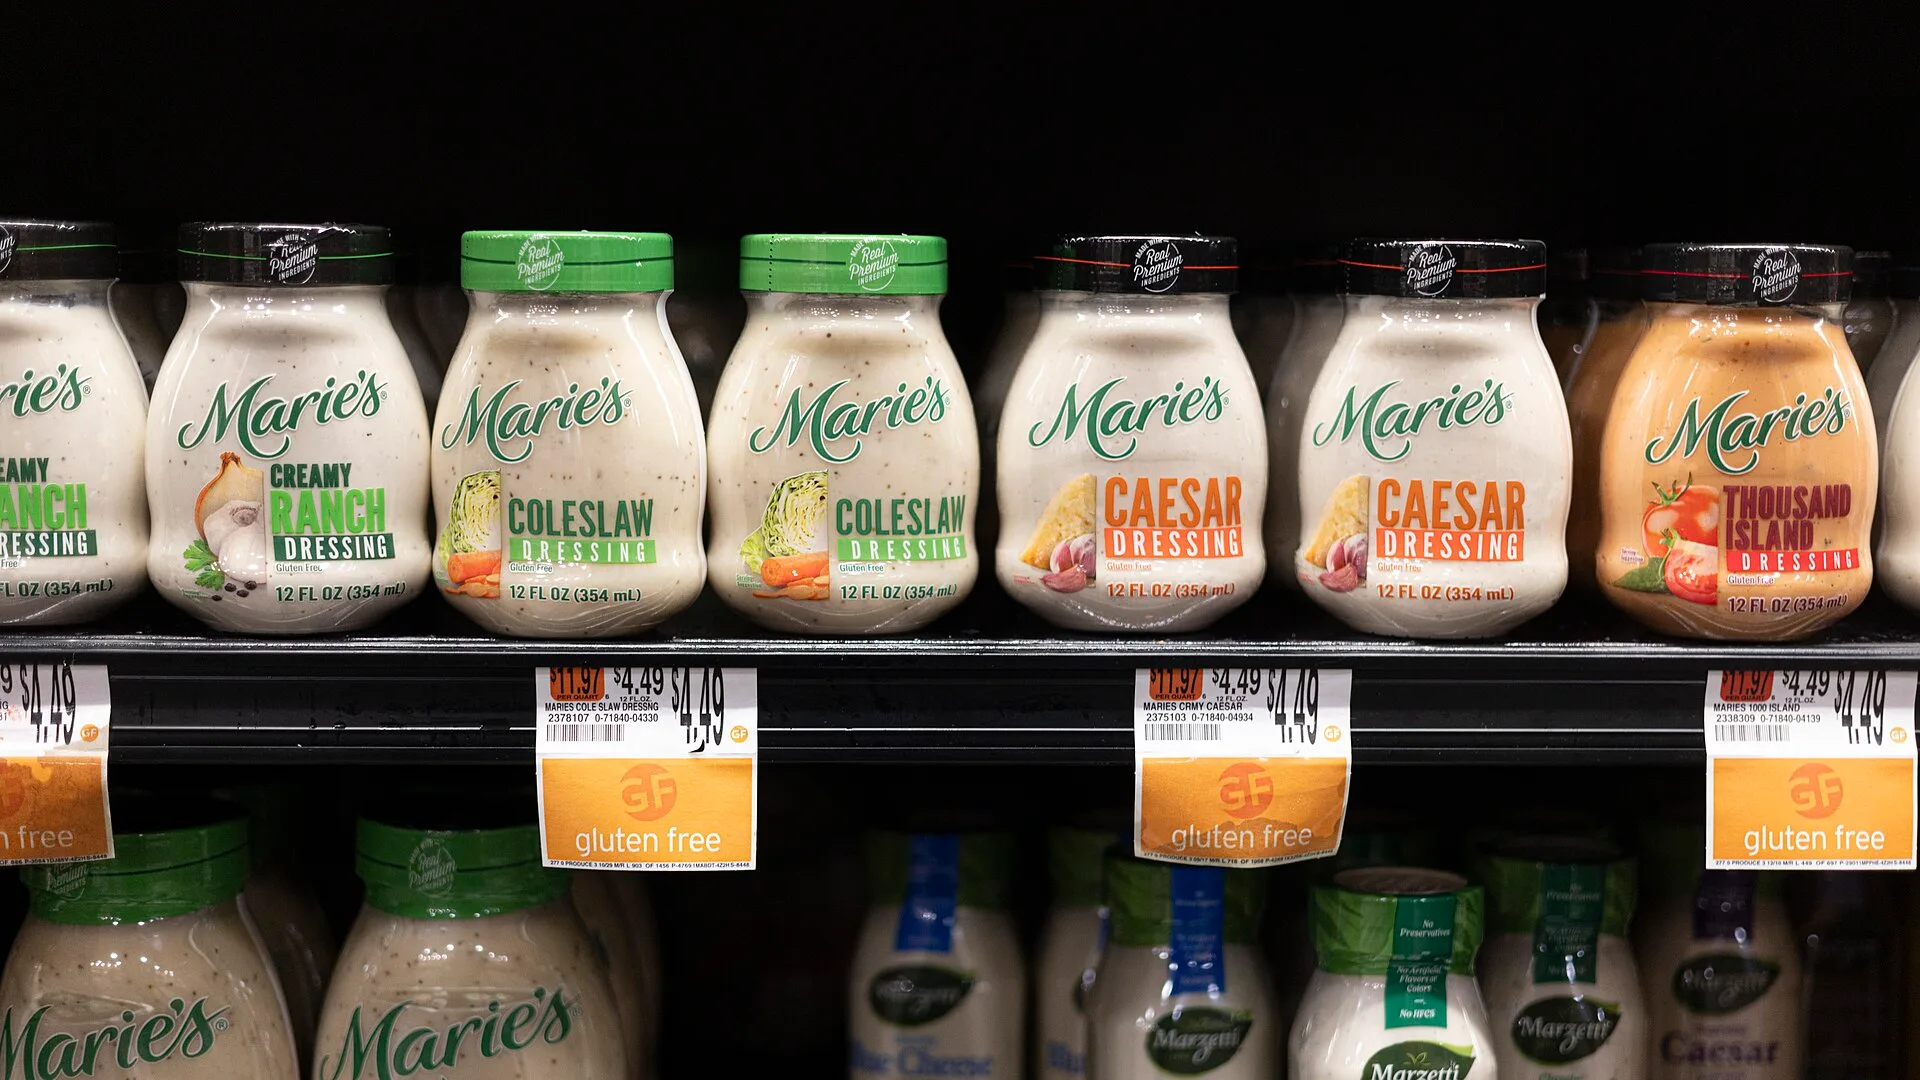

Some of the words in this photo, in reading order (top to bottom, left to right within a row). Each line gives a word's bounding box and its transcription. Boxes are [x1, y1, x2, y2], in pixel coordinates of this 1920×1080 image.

[528, 240, 551, 263] Real
[850, 239, 865, 257] MADE
[861, 240, 886, 264] Real
[1135, 242, 1149, 259] MADE
[1145, 243, 1171, 266] Real
[1418, 246, 1444, 268] Real
[269, 244, 319, 276] Premium
[278, 257, 317, 281] INGREDIENTS
[517, 251, 565, 280] Premium
[849, 252, 900, 281] Premium
[1133, 254, 1184, 282] Premium
[1406, 257, 1457, 285] Premium
[1753, 251, 1767, 270] MADE
[1763, 252, 1789, 276] Real
[524, 263, 562, 285] INGREDIENTS
[857, 264, 896, 286] INGREDIENTS
[1141, 266, 1180, 287] INGREDIENTS
[1413, 269, 1453, 290] INGREDIENTS
[1752, 262, 1802, 293] Premium
[1760, 275, 1799, 298] INGREDIENTS
[177, 369, 388, 458] Marie's
[441, 377, 634, 463] Marie's
[749, 376, 950, 463] Marie's
[1028, 376, 1231, 461] Marie's
[1313, 378, 1516, 462] Marie's
[1645, 387, 1851, 475] Marie's
[270, 463, 352, 488] CREAMY
[270, 488, 386, 534] RANCH
[1104, 476, 1242, 528] CAESAR
[1377, 478, 1526, 531] CAESAR
[1723, 483, 1852, 522] THOUSAND
[509, 498, 654, 538] COLESLAW
[836, 496, 967, 536] COLESLAW
[1113, 529, 1239, 557] DRESSING
[1384, 530, 1518, 560] DRESSING
[1726, 518, 1814, 551] ISLAND
[285, 535, 388, 560] DRESSING
[522, 539, 646, 562] DRESSING
[851, 537, 963, 559] DRESSING
[276, 563, 303, 573] Gluten
[510, 563, 534, 573] Gluten
[536, 563, 553, 573] Free
[839, 563, 865, 574] Gluten
[867, 563, 884, 573] Free
[1107, 561, 1133, 571] Gluten
[1377, 561, 1402, 573] Gluten
[1742, 551, 1854, 571] DRESSING
[18, 582, 40, 597] OZ
[44, 582, 80, 598] (354
[86, 579, 113, 593] mL)
[1107, 583, 1125, 597] 12
[1129, 583, 1147, 597] FL
[1151, 583, 1171, 597] OZ
[1175, 583, 1208, 599] (354
[1212, 581, 1235, 596] mL)
[1728, 574, 1754, 585] Gluten
[276, 586, 294, 602] 12
[299, 586, 318, 601] FL
[323, 586, 343, 601] OZ
[347, 584, 380, 601] (354
[384, 582, 406, 597] mL)
[510, 585, 525, 600] 12
[530, 585, 547, 600] FL
[551, 586, 570, 601] OZ
[574, 587, 609, 603] (354
[613, 588, 642, 603] mL)
[841, 586, 858, 599] 12
[862, 586, 879, 599] FL
[883, 586, 901, 599] OZ
[905, 585, 935, 601] (354
[937, 583, 957, 597] mL)
[1377, 584, 1394, 598] 12
[1399, 584, 1417, 598] FL
[1421, 585, 1442, 599] OZ
[1446, 585, 1481, 601] (354
[1487, 586, 1514, 601] mL)
[1728, 597, 1746, 612] 12
[1750, 597, 1767, 612] FL
[1772, 598, 1790, 612] OZ
[1793, 597, 1824, 612] (354
[1826, 594, 1847, 609] mL)
[20, 665, 75, 745] $4.49
[545, 702, 574, 711] MARIES
[576, 702, 597, 711] COLE
[598, 702, 620, 711] SLAW
[622, 702, 659, 711] DRESSNG
[614, 667, 664, 695] $4.49
[672, 668, 724, 746] $4.49
[1144, 702, 1176, 711] MARIES
[1179, 702, 1204, 711] CRMY
[1206, 702, 1242, 711] CAESAR
[1212, 668, 1261, 695] $4.49
[1267, 669, 1318, 745] $4.49
[1714, 703, 1747, 712] MARIES
[1749, 703, 1767, 712] 1000
[1769, 703, 1800, 712] ISLAND
[1782, 670, 1830, 696] $4.49
[1835, 671, 1886, 746] $4.49
[549, 713, 589, 722] 2378107
[595, 713, 658, 722] 0-71840-04330
[1146, 713, 1186, 722] 2375103
[1191, 713, 1253, 722] 0-71840-04934
[1716, 714, 1755, 723] 2338309
[1760, 714, 1820, 723] 0-71840-04139
[82, 727, 98, 738] GF
[732, 730, 746, 739] GF
[1219, 770, 1271, 811] GF
[1790, 772, 1841, 812] GF
[18, 825, 73, 849] free
[576, 826, 658, 857] gluten
[667, 826, 721, 852] free
[1172, 824, 1254, 851] gluten
[1263, 824, 1312, 848] free
[1744, 825, 1826, 856] gluten
[1835, 825, 1885, 850] free
[1400, 928, 1451, 938] Preservatives
[1423, 919, 1434, 928] No
[1400, 975, 1429, 983] Flavors
[1407, 984, 1432, 993] Colors
[1400, 1008, 1412, 1018] No
[1413, 1008, 1436, 1018] HFCS
[0, 996, 230, 1080] Marie's
[320, 987, 582, 1080] Marie's
[1517, 1016, 1612, 1055] Marzetti
[1153, 1027, 1241, 1066] Marzetti
